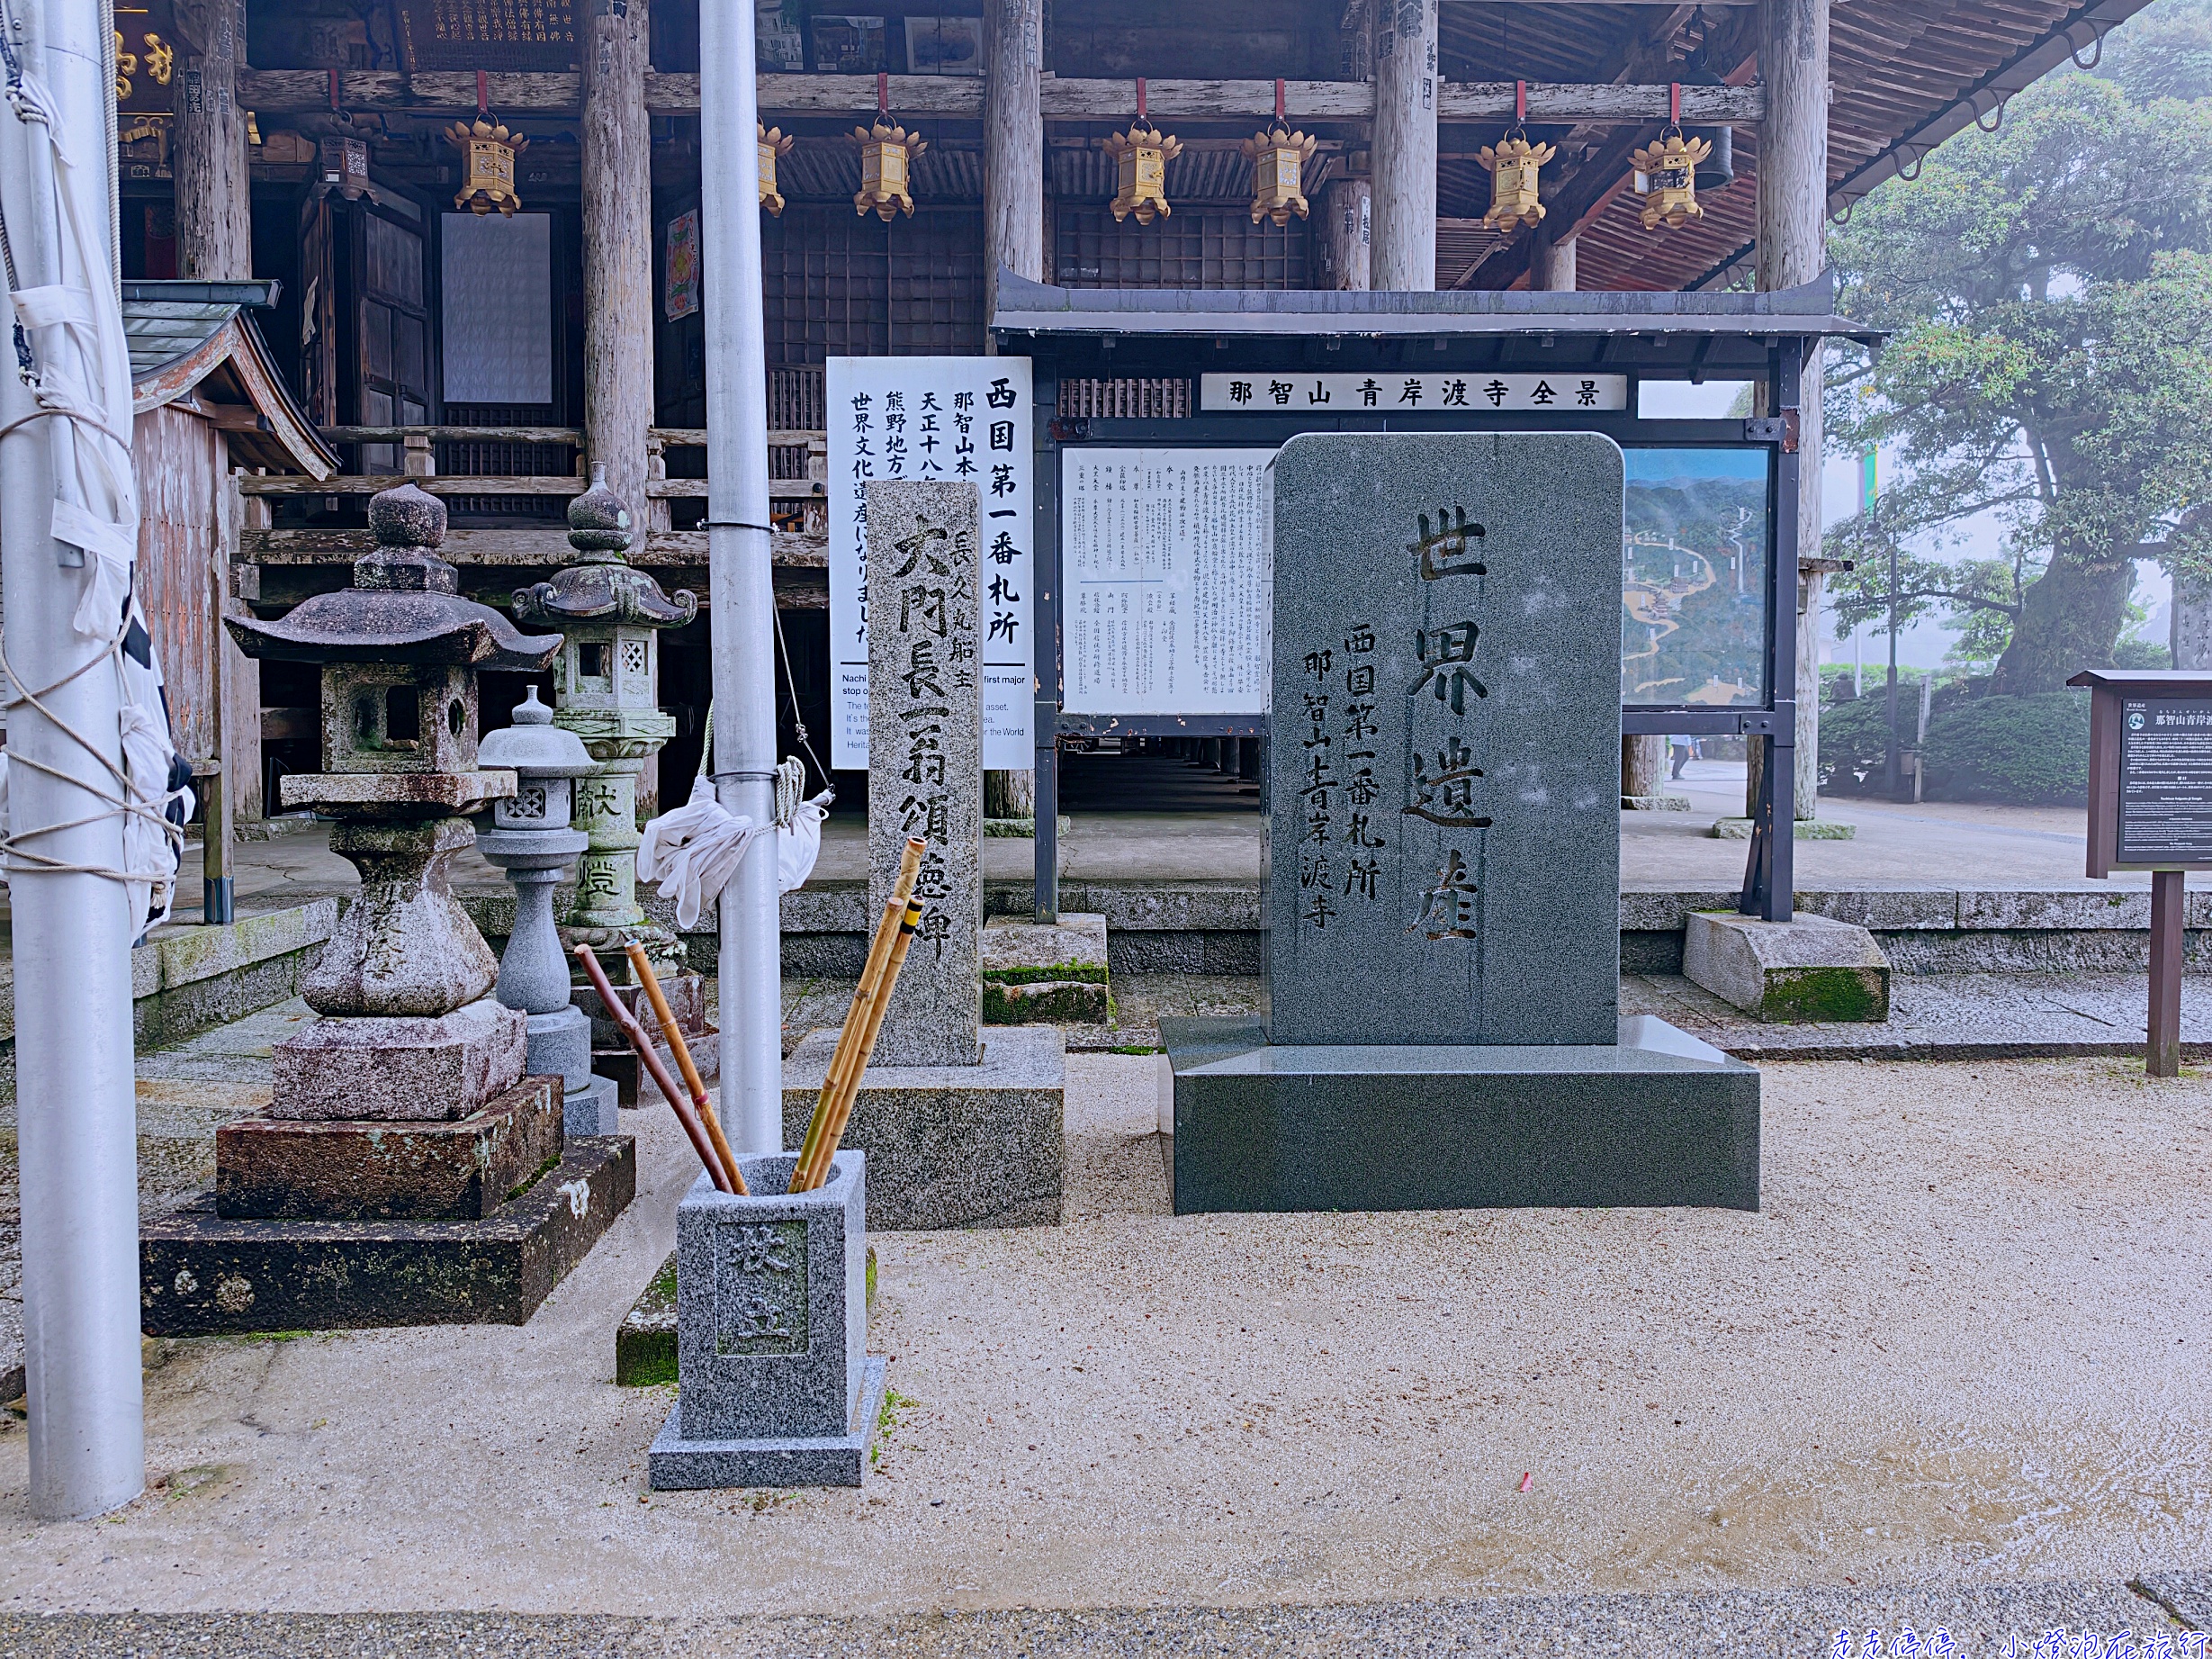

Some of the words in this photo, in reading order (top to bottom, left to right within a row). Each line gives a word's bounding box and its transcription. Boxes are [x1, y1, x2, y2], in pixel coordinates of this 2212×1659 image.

[953, 391, 979, 481] 那智山本
[1229, 378, 1600, 407] 那智山青岸渡寺全景
[986, 377, 1023, 645] 西国第一番札所
[842, 674, 867, 682] Nachi
[984, 675, 1000, 684] first
[1002, 675, 1025, 686] major
[842, 687, 861, 697] stop
[847, 701, 862, 710] The
[985, 703, 1009, 711] asset.
[1404, 505, 1492, 942] 世界遺産
[846, 727, 851, 735] It
[990, 727, 1002, 736] the
[1003, 727, 1024, 736] World
[1343, 623, 1386, 901] 西国第一番札所
[1299, 649, 1339, 930] 那智山青岸渡寺
[730, 1224, 791, 1340] 杖立
